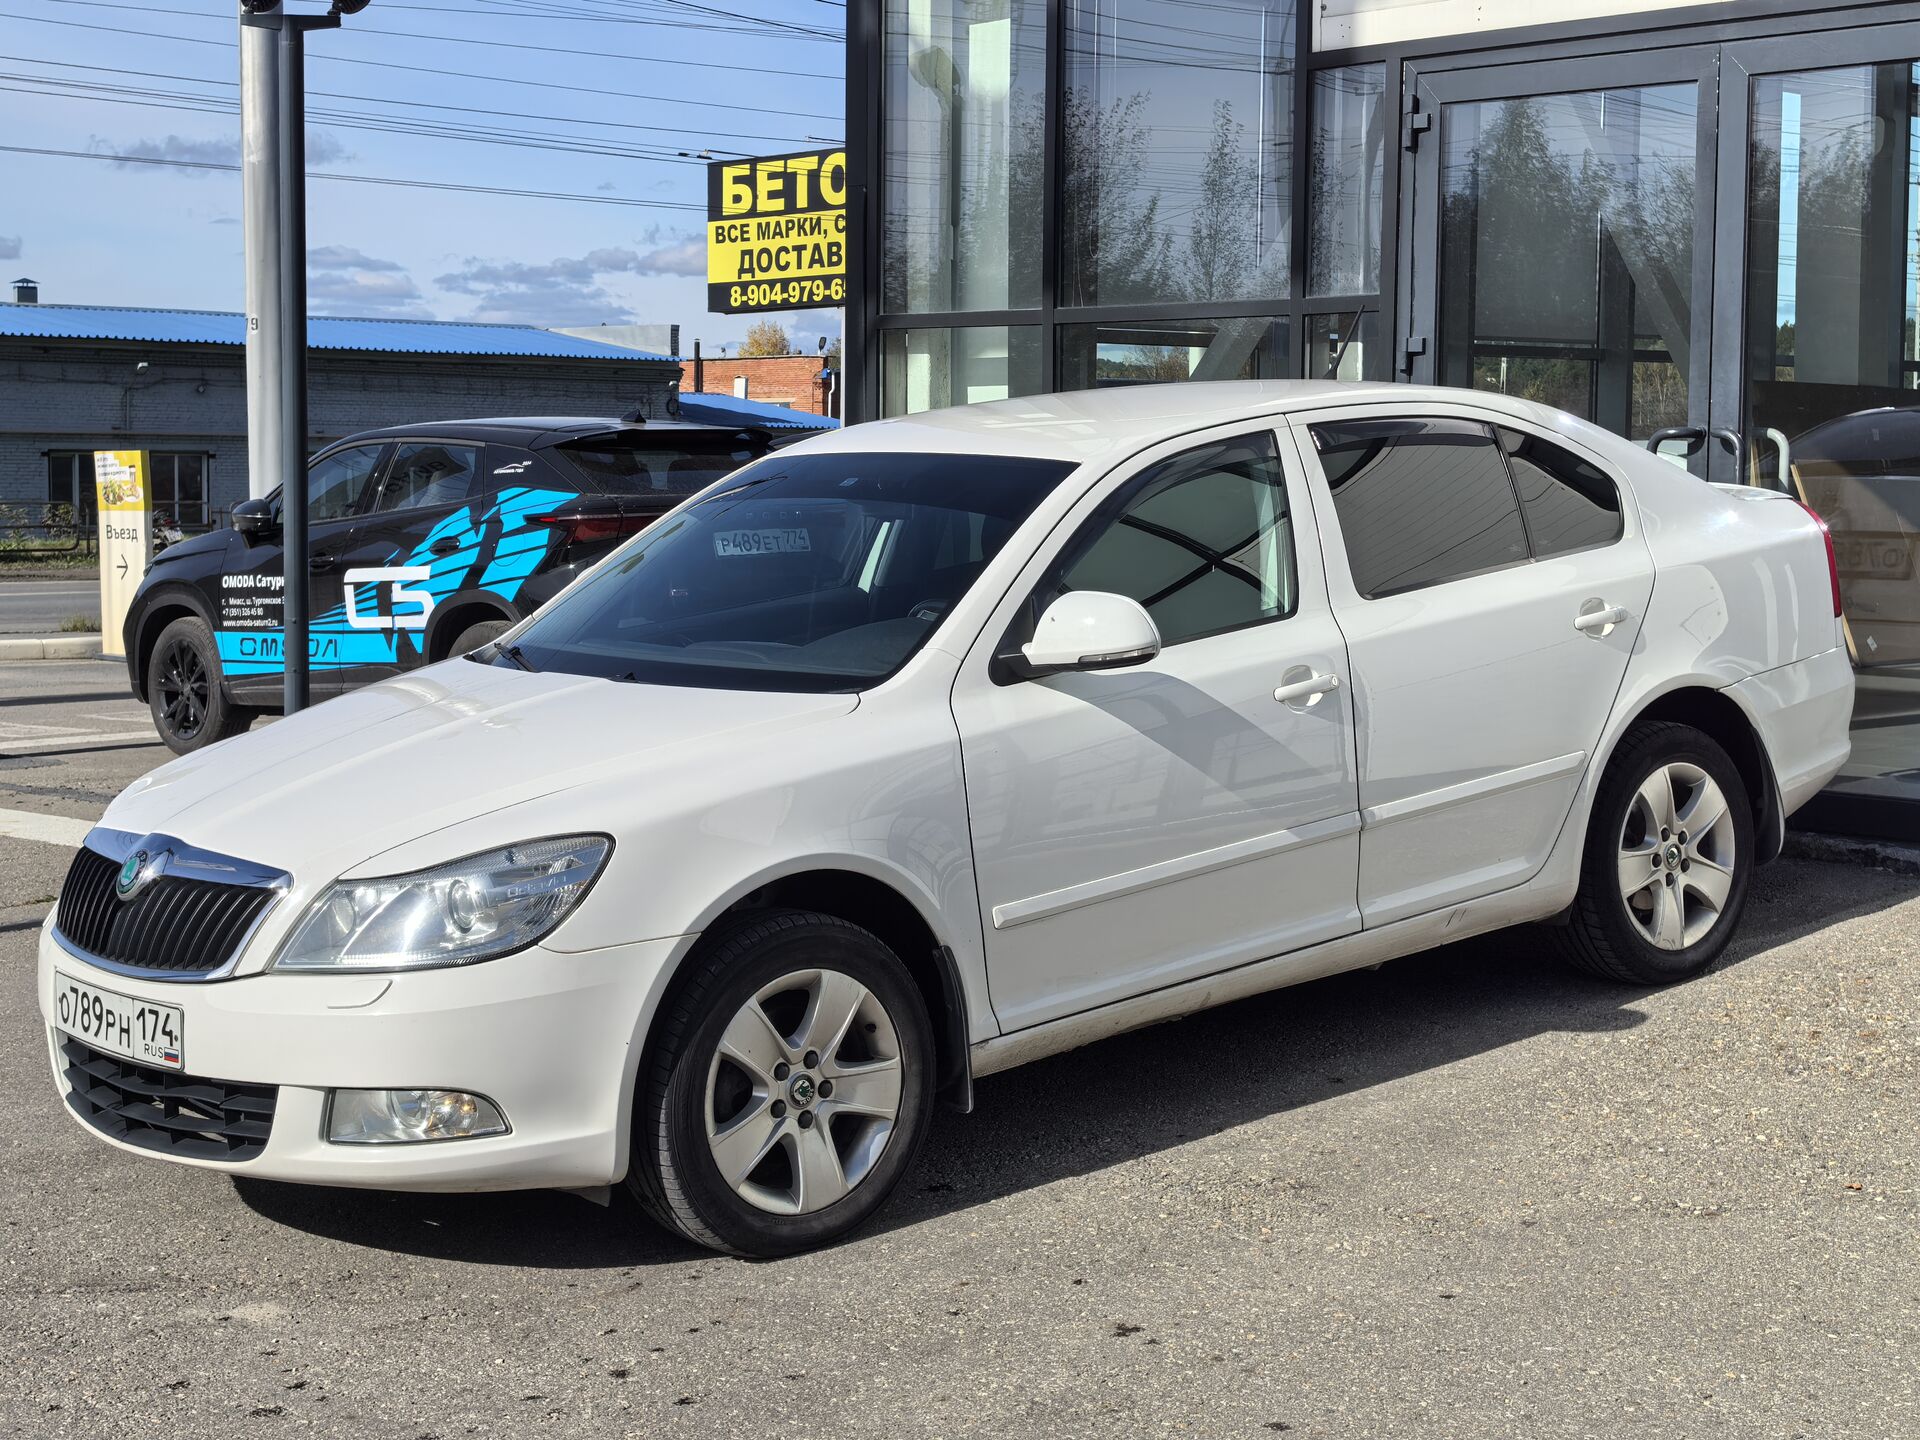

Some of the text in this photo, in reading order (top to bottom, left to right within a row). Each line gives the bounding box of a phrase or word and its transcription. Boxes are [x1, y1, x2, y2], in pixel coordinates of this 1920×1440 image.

[715, 223, 750, 244] ВСЕ
[757, 216, 828, 241] МАРКИ,
[737, 241, 843, 280] ДОСТАВ
[730, 278, 846, 307] 8-904-979-6
[106, 524, 138, 543] Въезд
[222, 574, 255, 589] OMODA
[240, 637, 338, 658] OMDA
[136, 1007, 174, 1047] 174
[144, 1043, 164, 1059] RUS
